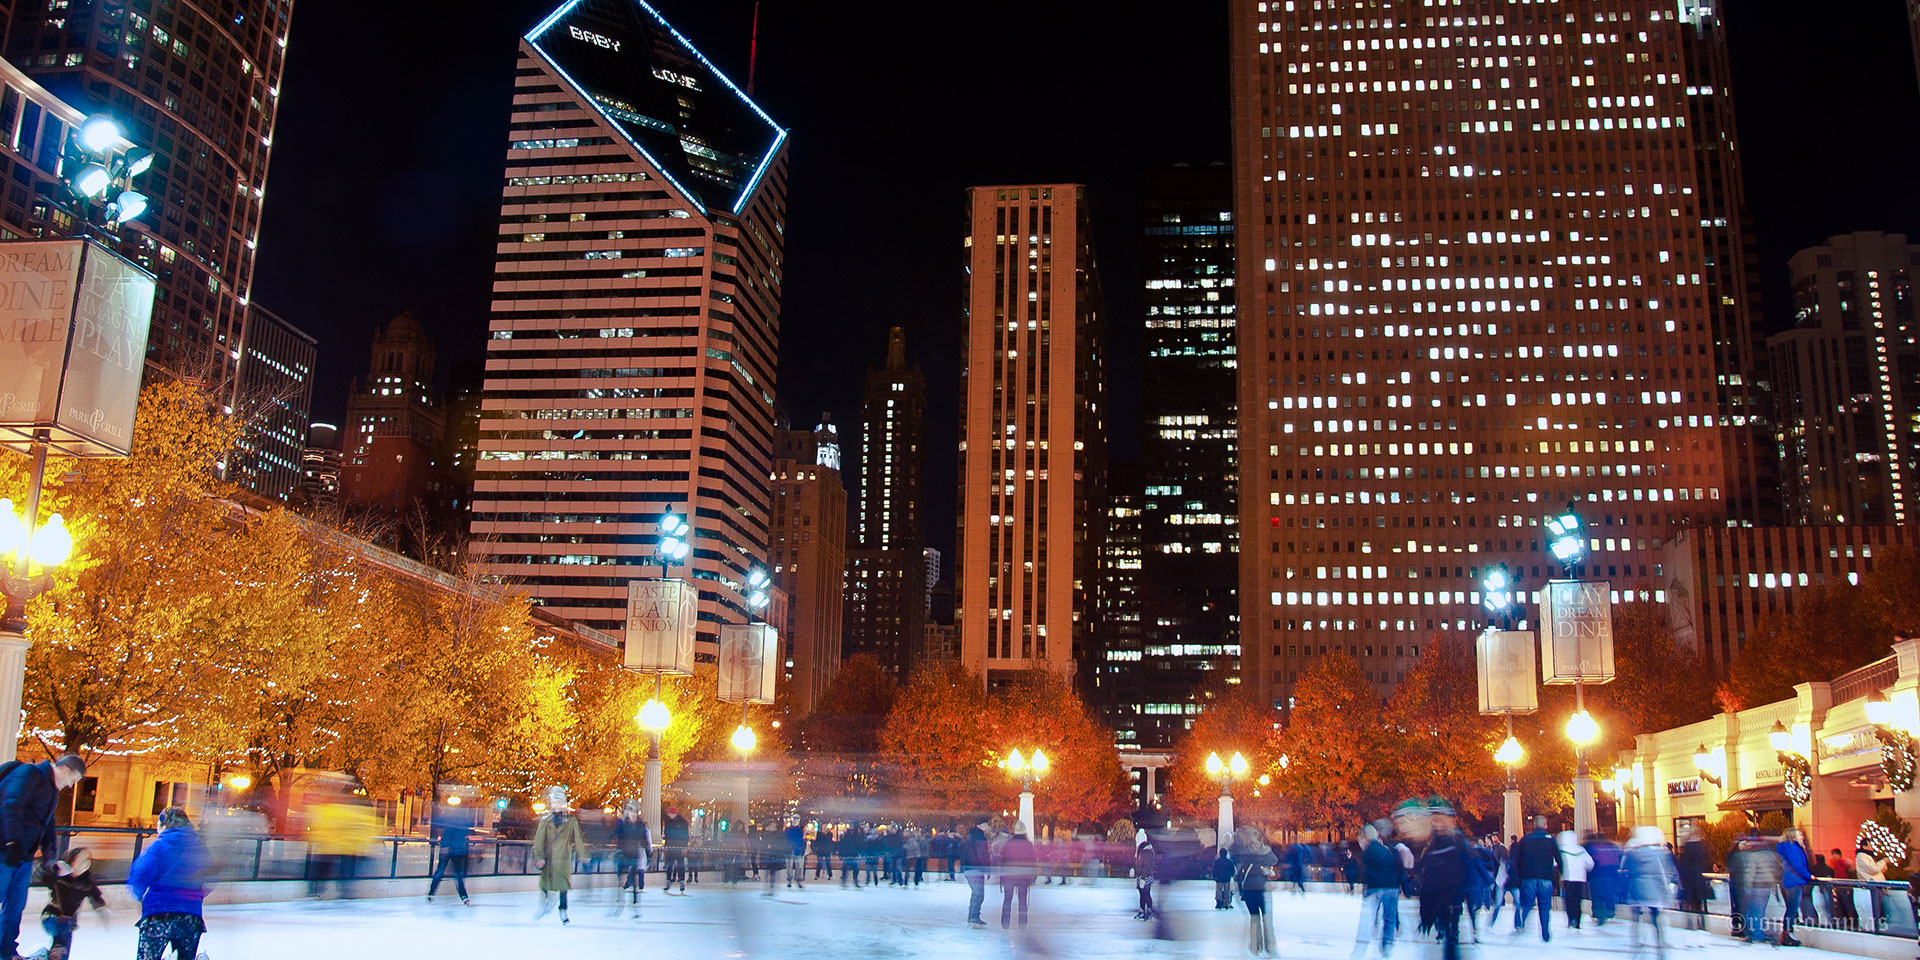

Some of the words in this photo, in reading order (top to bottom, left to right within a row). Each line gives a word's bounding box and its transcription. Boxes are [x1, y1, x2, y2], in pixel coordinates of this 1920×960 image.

[569, 25, 621, 52] BABY
[85, 259, 144, 319] EAT
[82, 295, 146, 341] IMAGINE
[77, 317, 142, 374] PLAY
[69, 407, 90, 425] PARK
[100, 423, 125, 439] GRILL
[633, 585, 678, 599] TASTE
[1556, 588, 1606, 605] PLAY
[632, 600, 676, 618] EAT
[1557, 607, 1608, 618] DREAM
[630, 620, 676, 633] ENJOY
[1558, 621, 1609, 637] DINE
